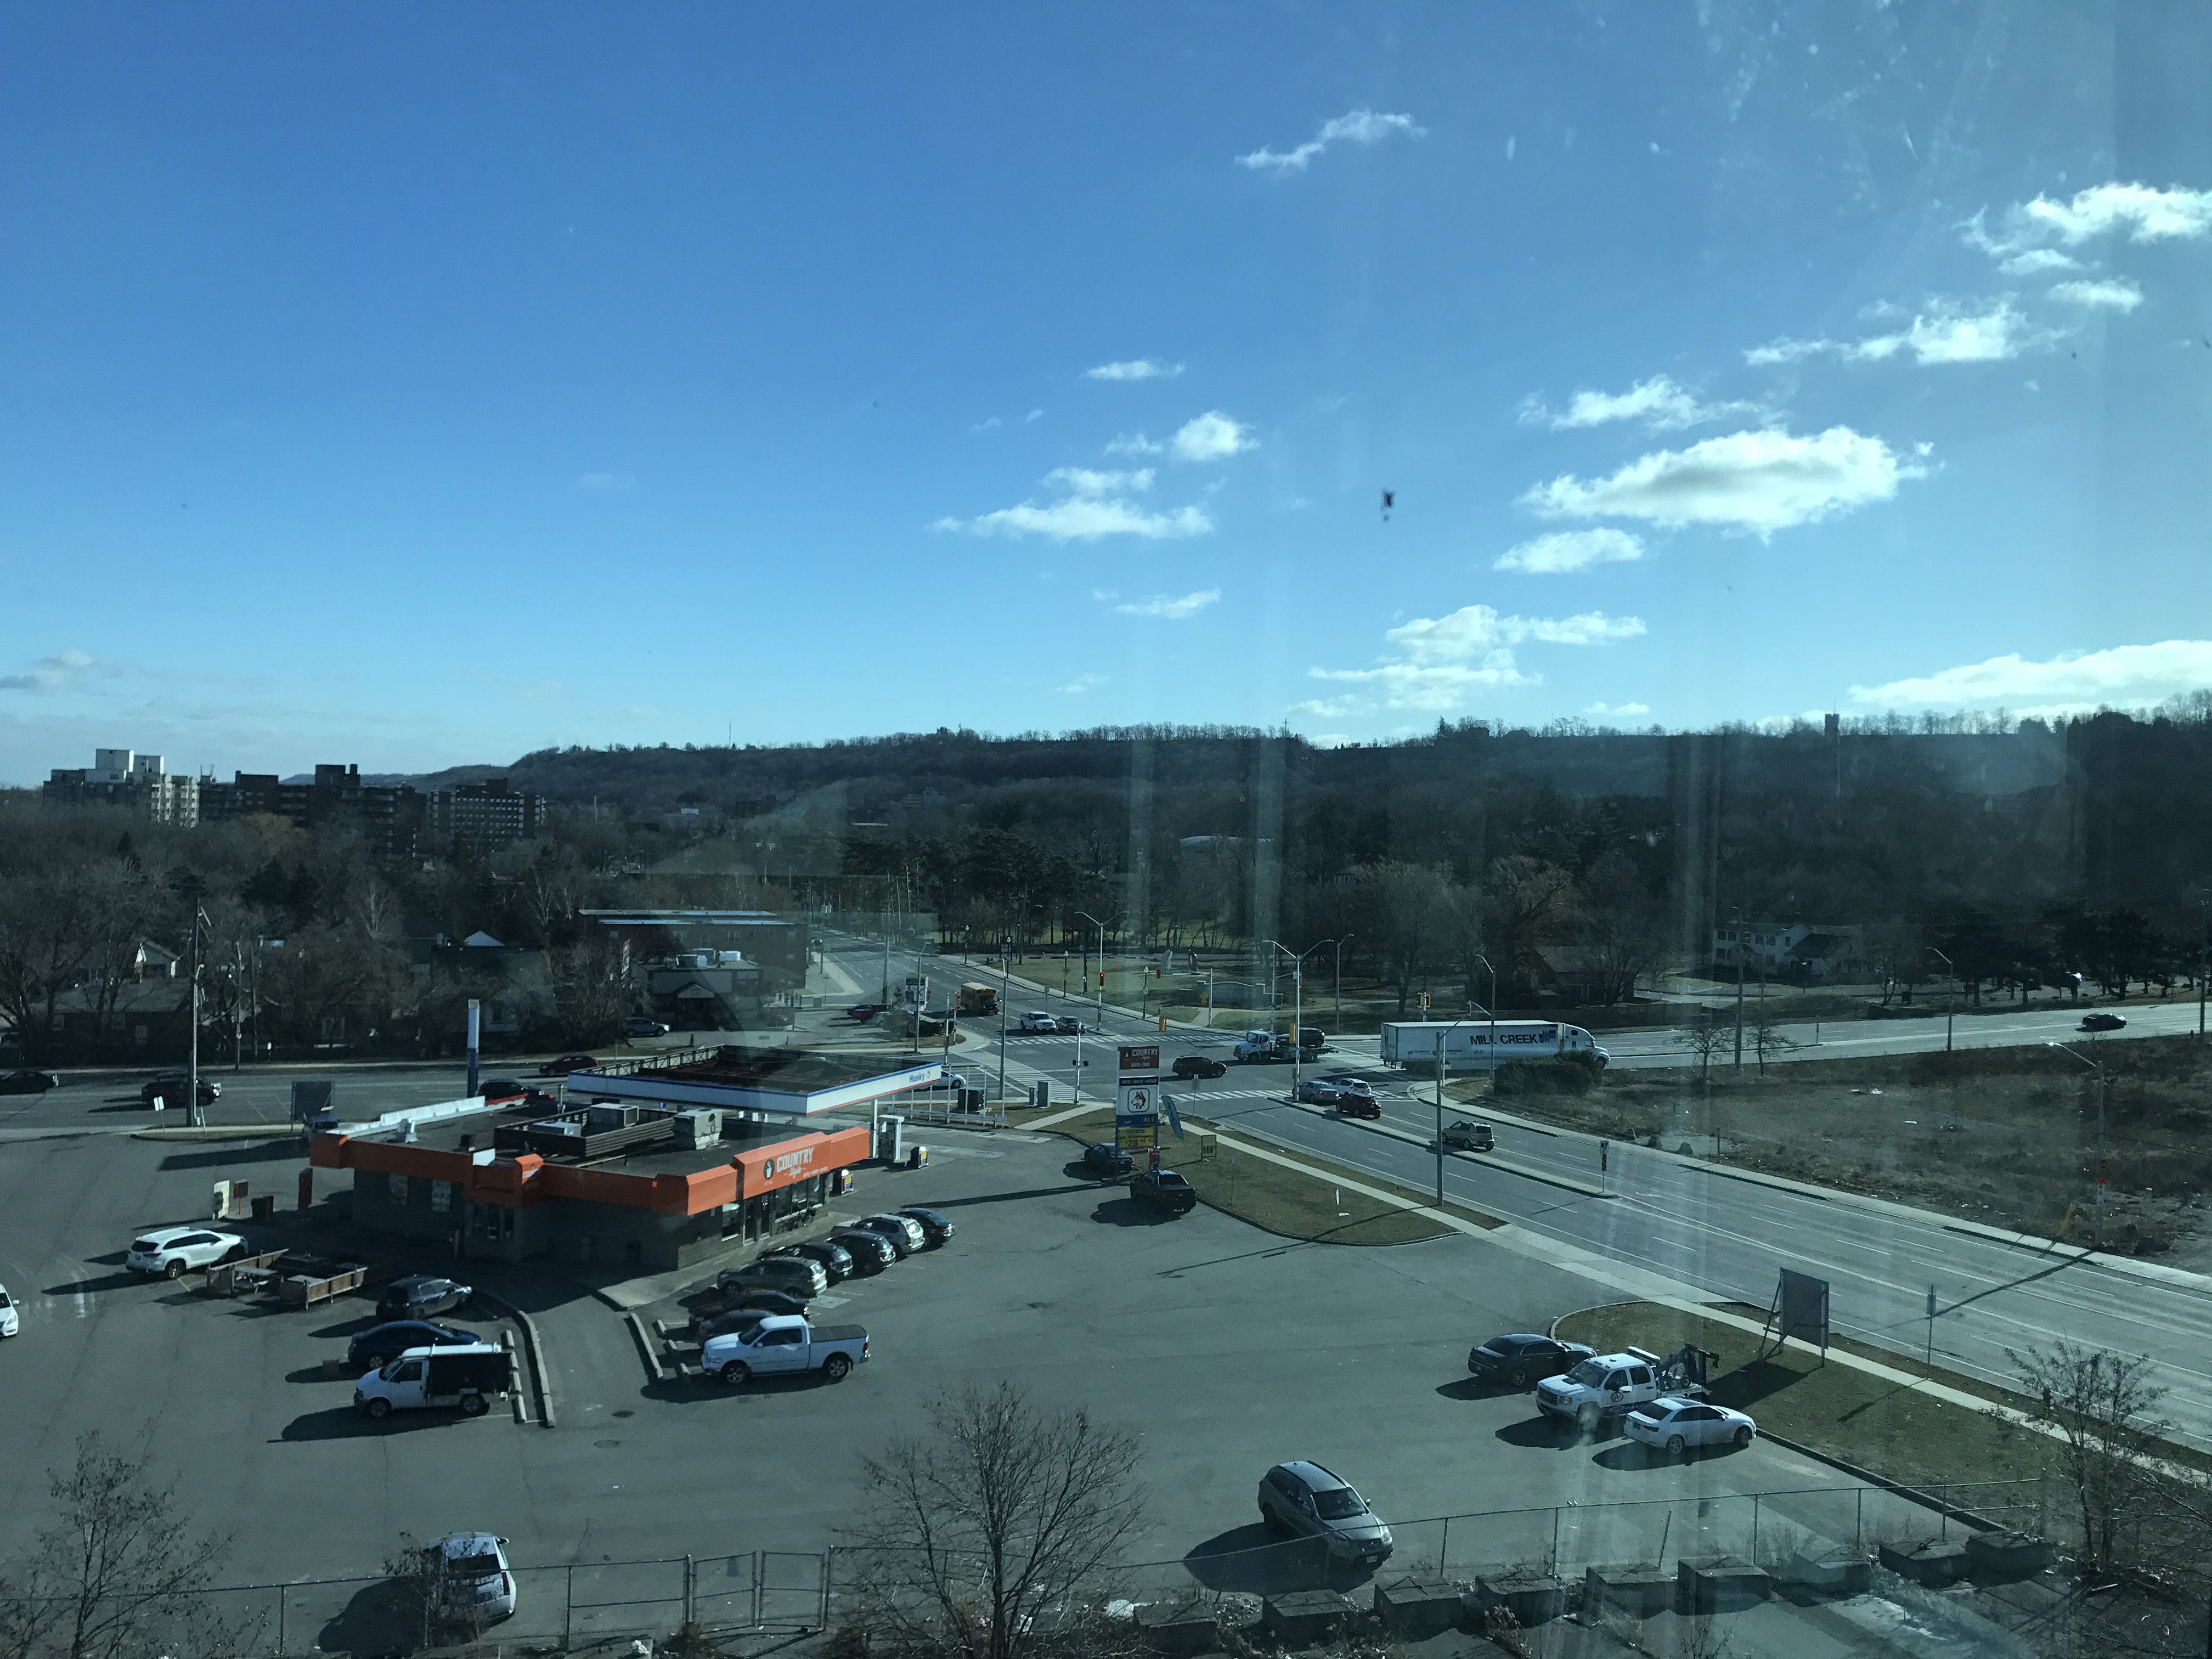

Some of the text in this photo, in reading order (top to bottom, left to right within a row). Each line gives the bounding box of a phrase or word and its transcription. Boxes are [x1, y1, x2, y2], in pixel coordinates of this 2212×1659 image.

[1500, 1034, 1538, 1045] CREEK
[1132, 1048, 1158, 1057] COUNTRY
[909, 1073, 925, 1082] Husky
[777, 1147, 814, 1173] COUNTRY
